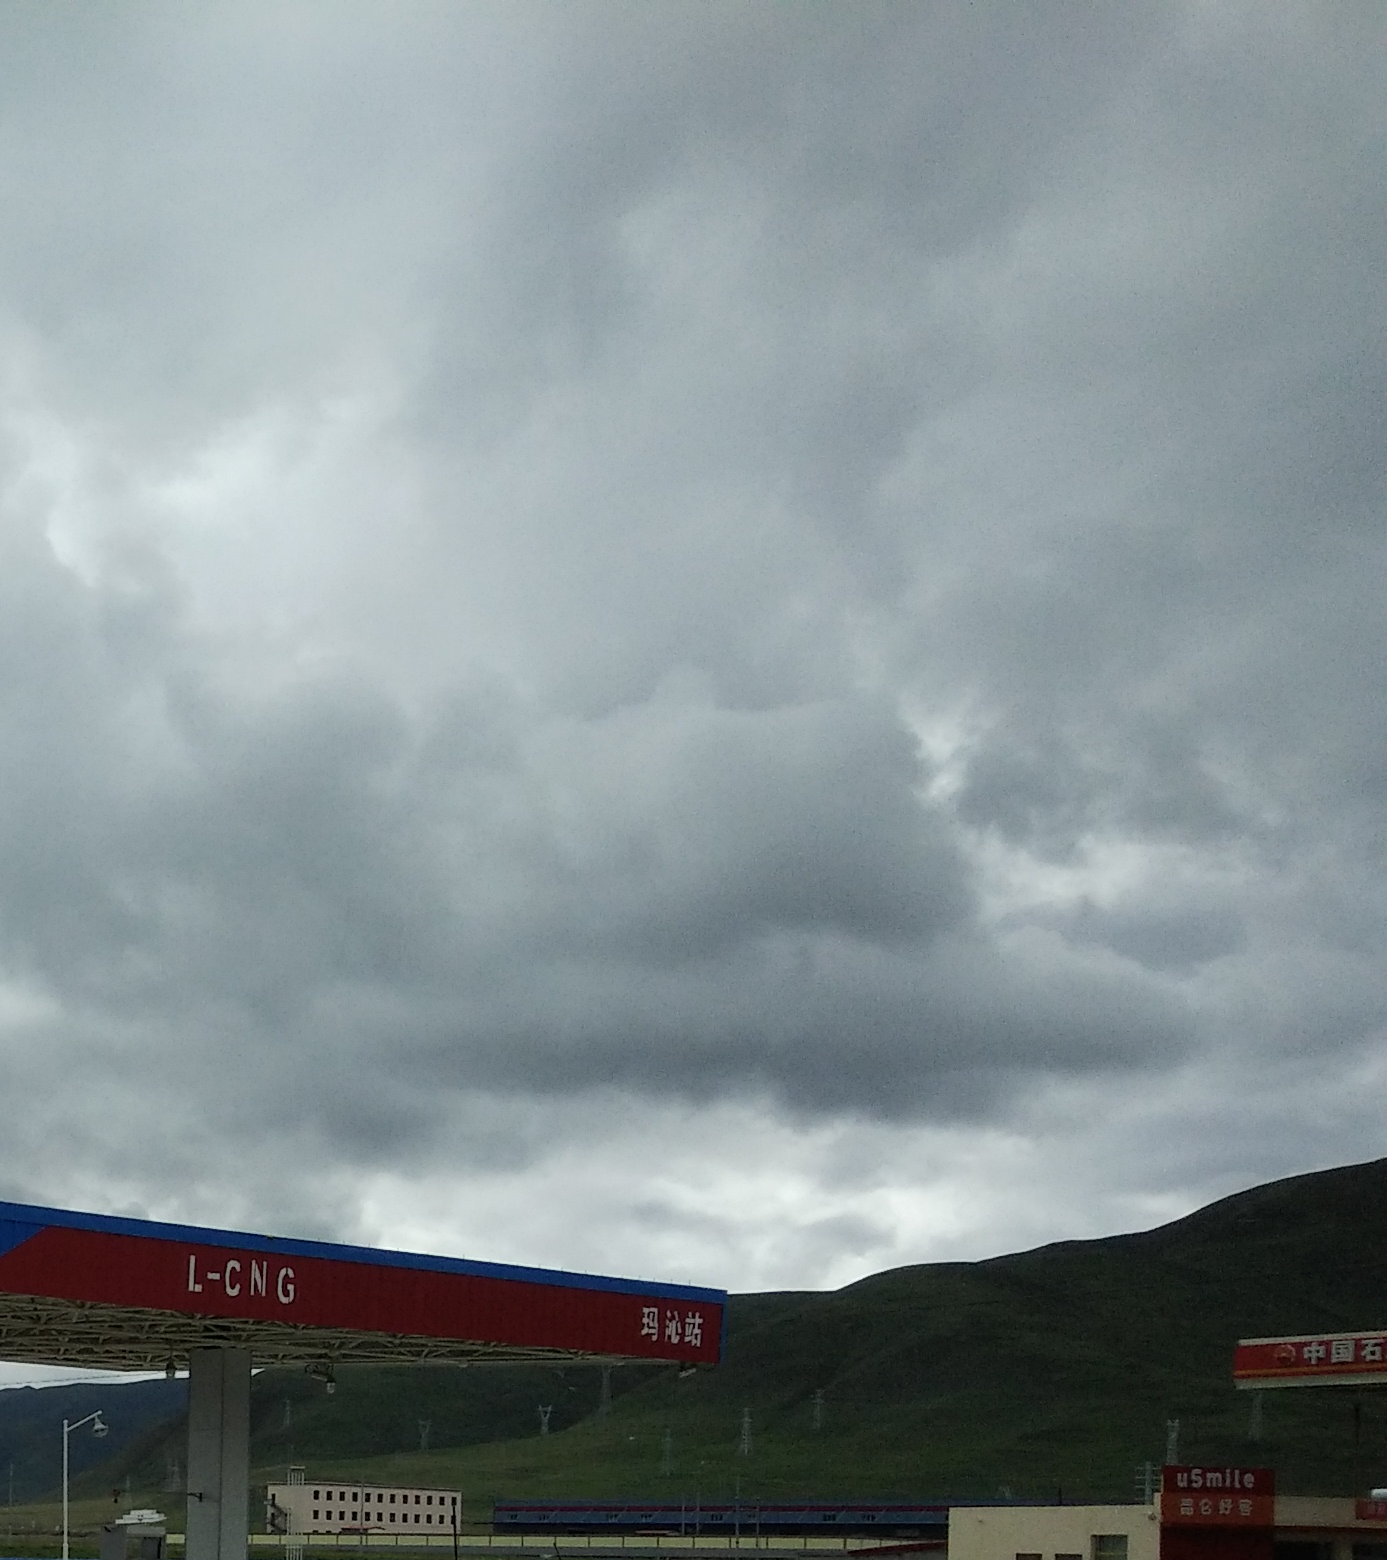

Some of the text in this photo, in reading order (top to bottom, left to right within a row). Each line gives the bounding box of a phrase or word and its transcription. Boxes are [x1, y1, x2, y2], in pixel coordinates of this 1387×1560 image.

[188, 1254, 295, 1304] L-CNG
[640, 1306, 704, 1347] 玛沁站
[1303, 1338, 1387, 1365] 中国石
[1176, 1468, 1256, 1489] uSmile
